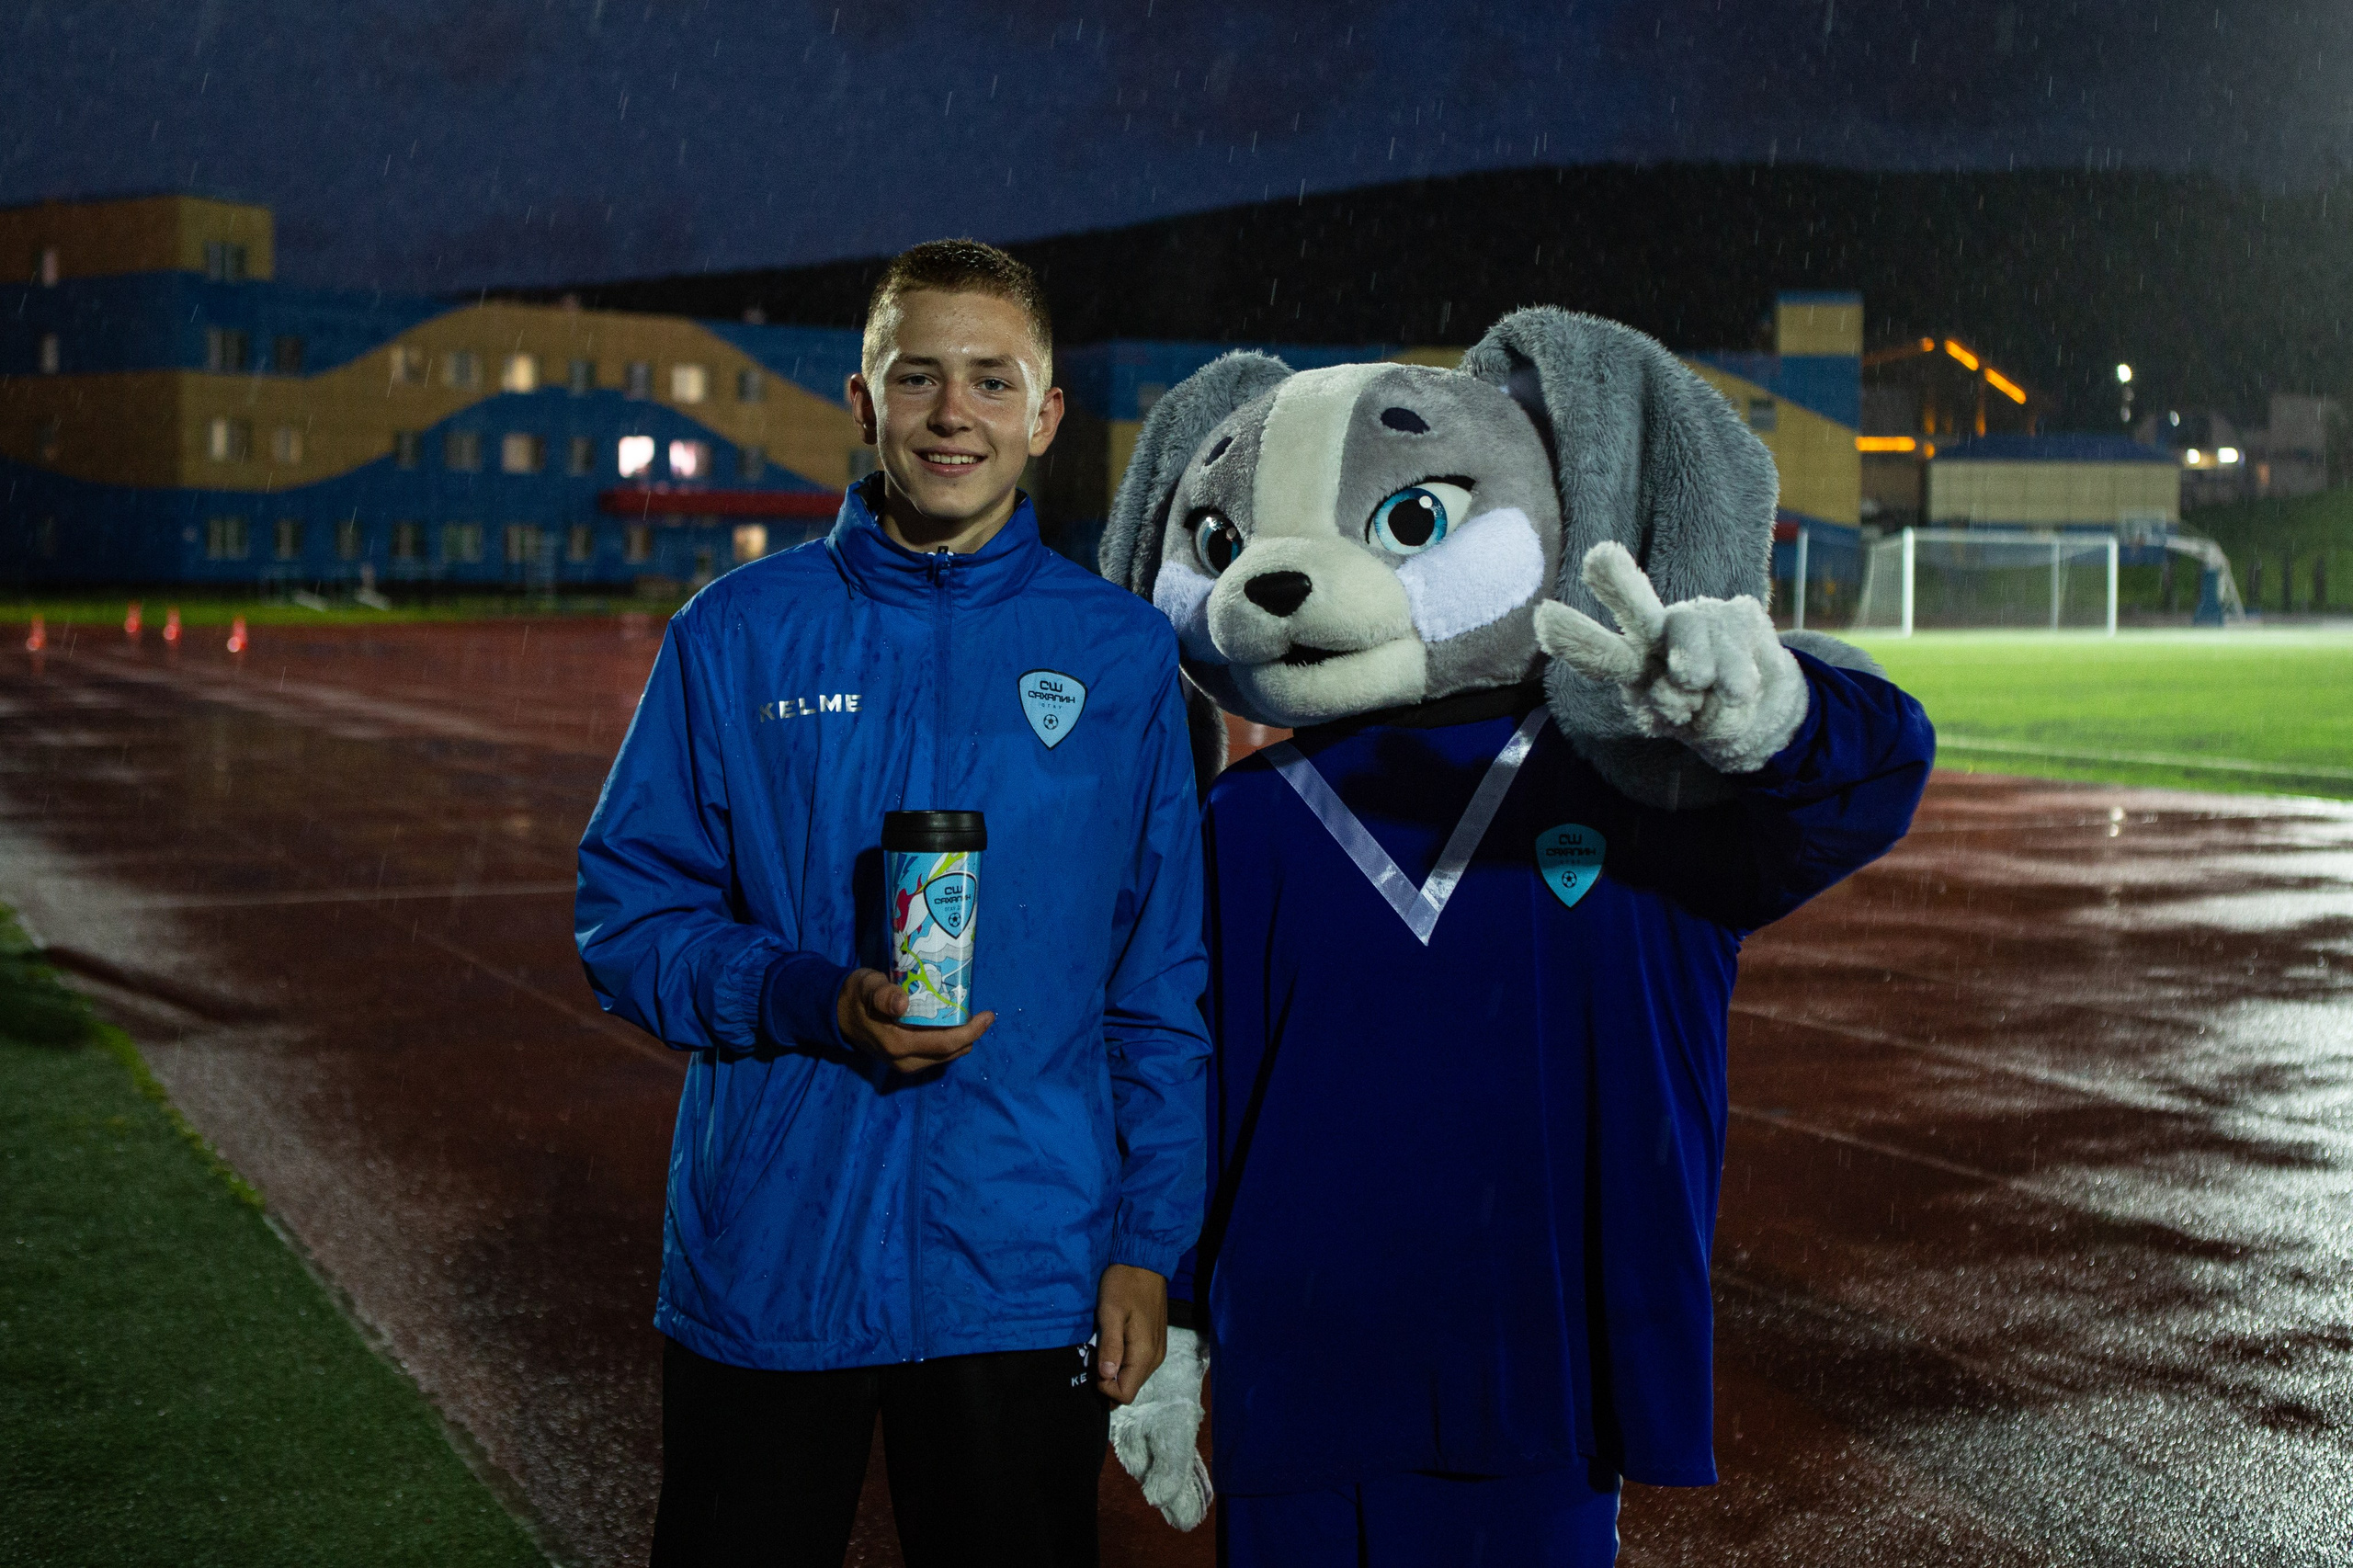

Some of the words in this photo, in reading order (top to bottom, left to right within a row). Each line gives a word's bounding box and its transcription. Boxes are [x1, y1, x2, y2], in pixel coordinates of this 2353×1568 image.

[1040, 680, 1063, 692] СШ
[1028, 690, 1075, 704] САХАЛИН
[759, 693, 862, 723] KELME
[1559, 833, 1583, 845] СШ
[945, 885, 963, 895] СШ
[934, 893, 972, 904] САХАЛН
